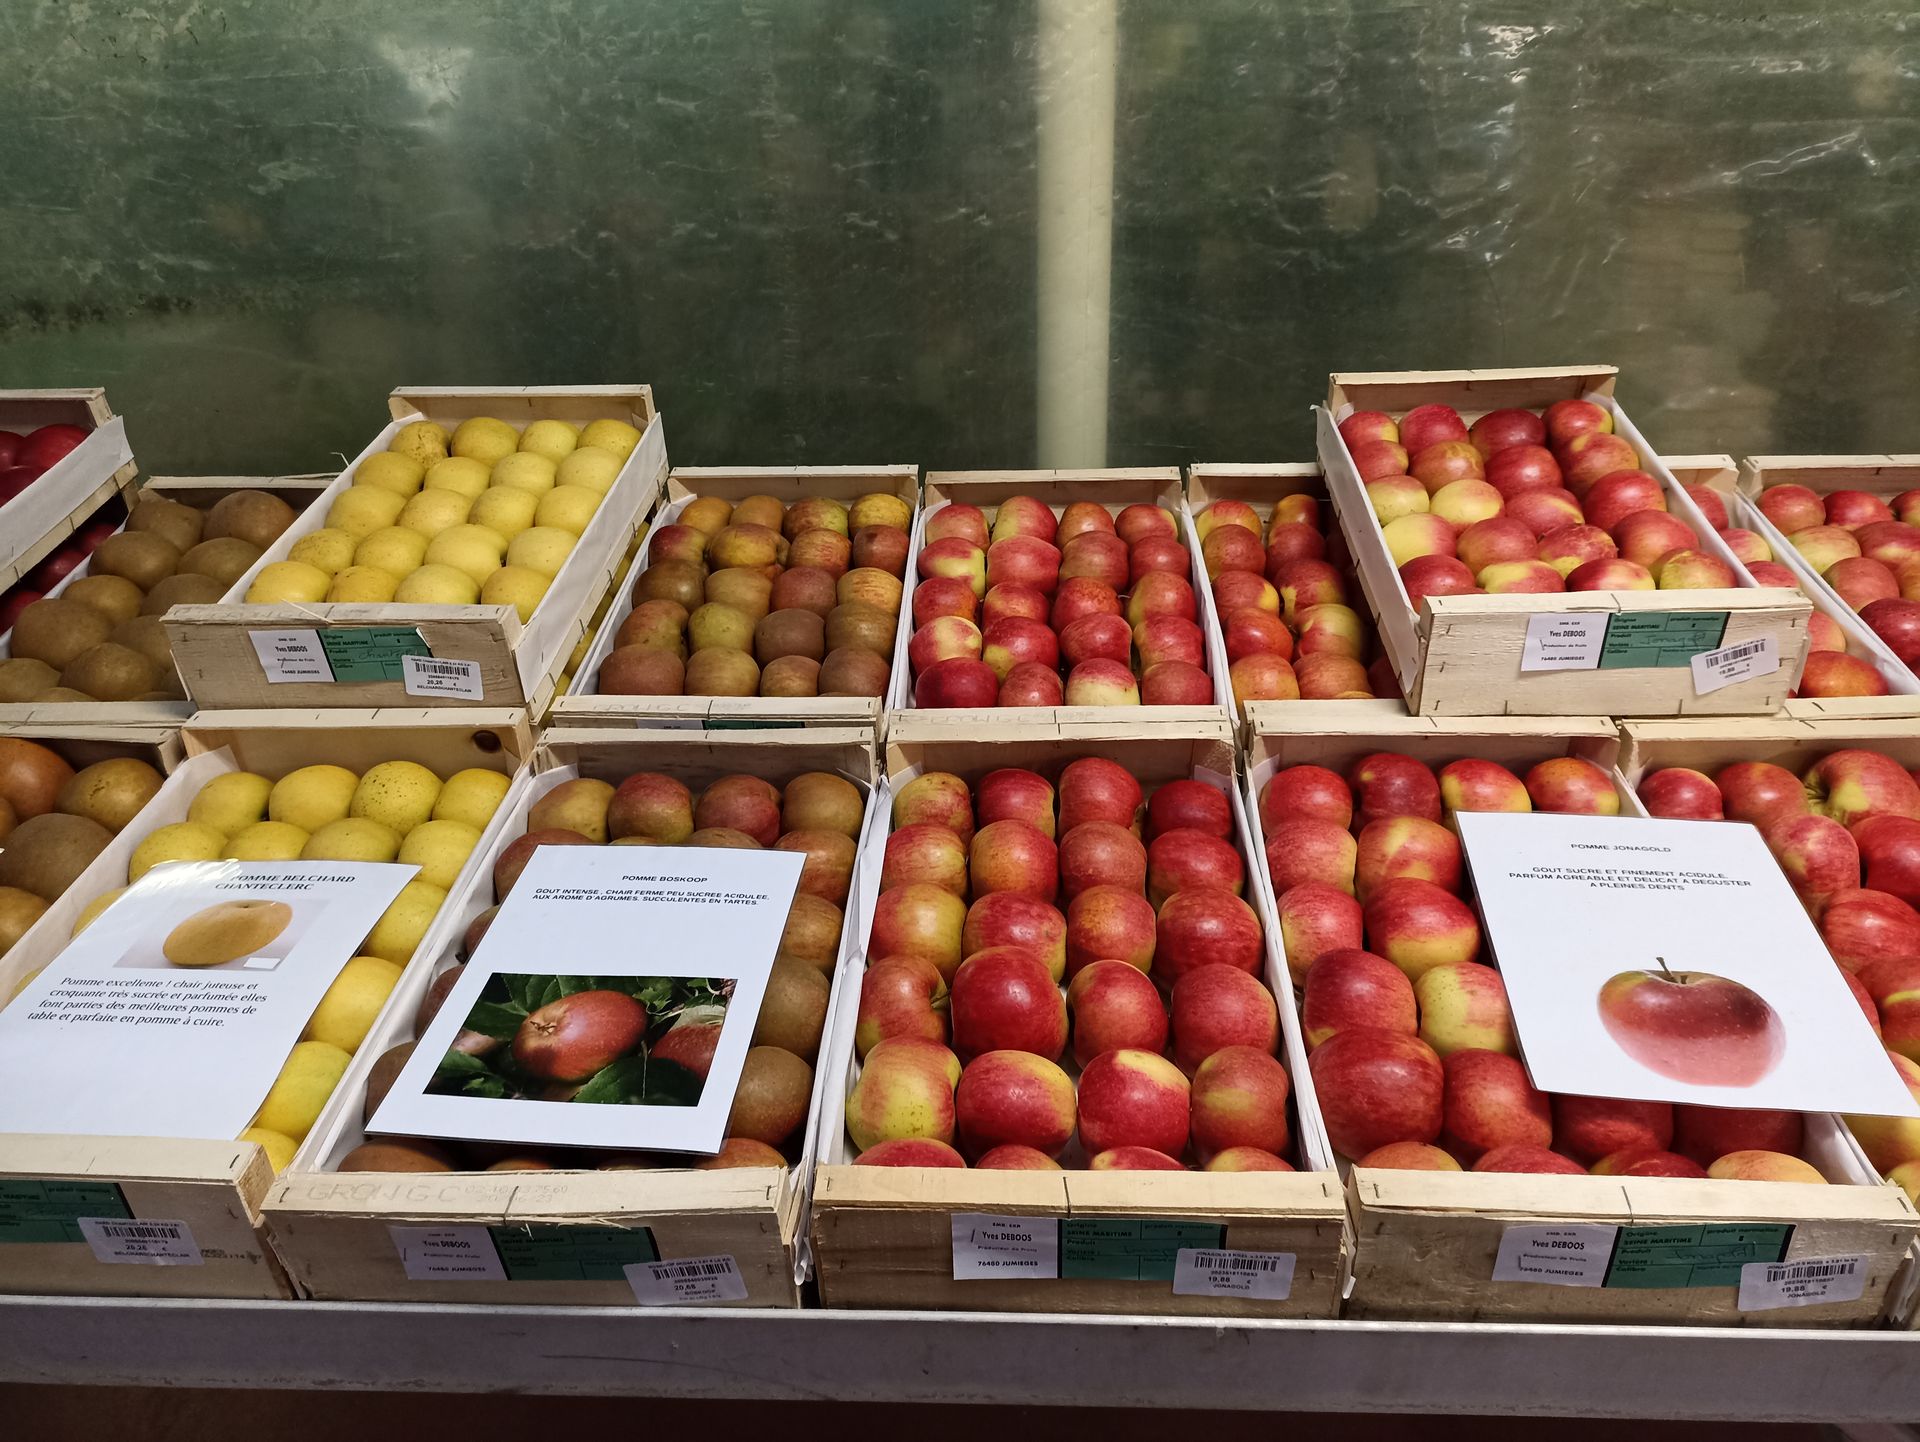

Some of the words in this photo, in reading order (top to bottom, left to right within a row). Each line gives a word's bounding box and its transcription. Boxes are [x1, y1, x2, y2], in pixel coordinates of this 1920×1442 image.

[60, 977, 104, 986] Pomme
[106, 979, 163, 987] excellente
[174, 980, 200, 989] chair
[202, 981, 244, 991] juteuse
[49, 990, 106, 998] croquante
[108, 990, 129, 998] très
[131, 991, 168, 999] sucrée
[182, 992, 239, 1002] parfumée
[240, 994, 268, 1002] elles
[38, 999, 64, 1008] font
[62, 1001, 104, 1010] parties
[106, 1001, 126, 1010] des
[127, 1002, 187, 1011] meilleures
[188, 1005, 239, 1014] pommes
[241, 1005, 257, 1014] de
[27, 1011, 57, 1020] table
[70, 1012, 118, 1023] parfaite
[134, 1016, 181, 1025] pomme
[183, 1016, 192, 1025] à
[193, 1018, 225, 1027] cuire.
[982, 1231, 999, 1240] Yves
[1001, 1232, 1032, 1242] DEBOOS
[440, 1240, 471, 1249] DEBOOS
[1532, 1240, 1549, 1248] Yves
[1551, 1240, 1585, 1250] DEBOOS
[1544, 1268, 1584, 1276] JUMIEGES
